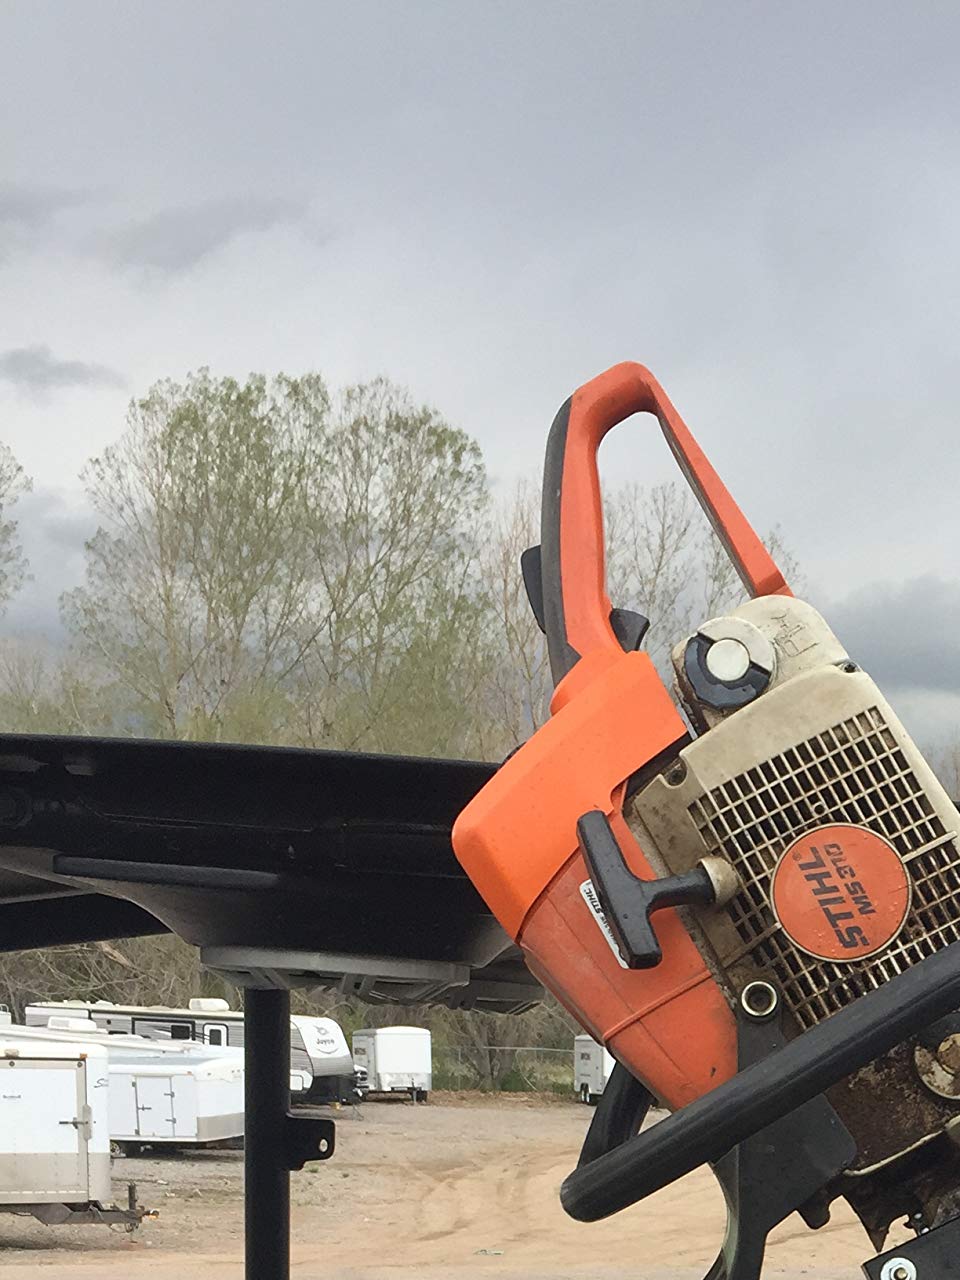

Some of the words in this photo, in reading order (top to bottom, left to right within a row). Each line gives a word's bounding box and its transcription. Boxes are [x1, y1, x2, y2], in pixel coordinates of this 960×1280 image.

[585, 888, 602, 914] STIHL
[798, 847, 870, 949] STIHL
[844, 881, 877, 916] MS
